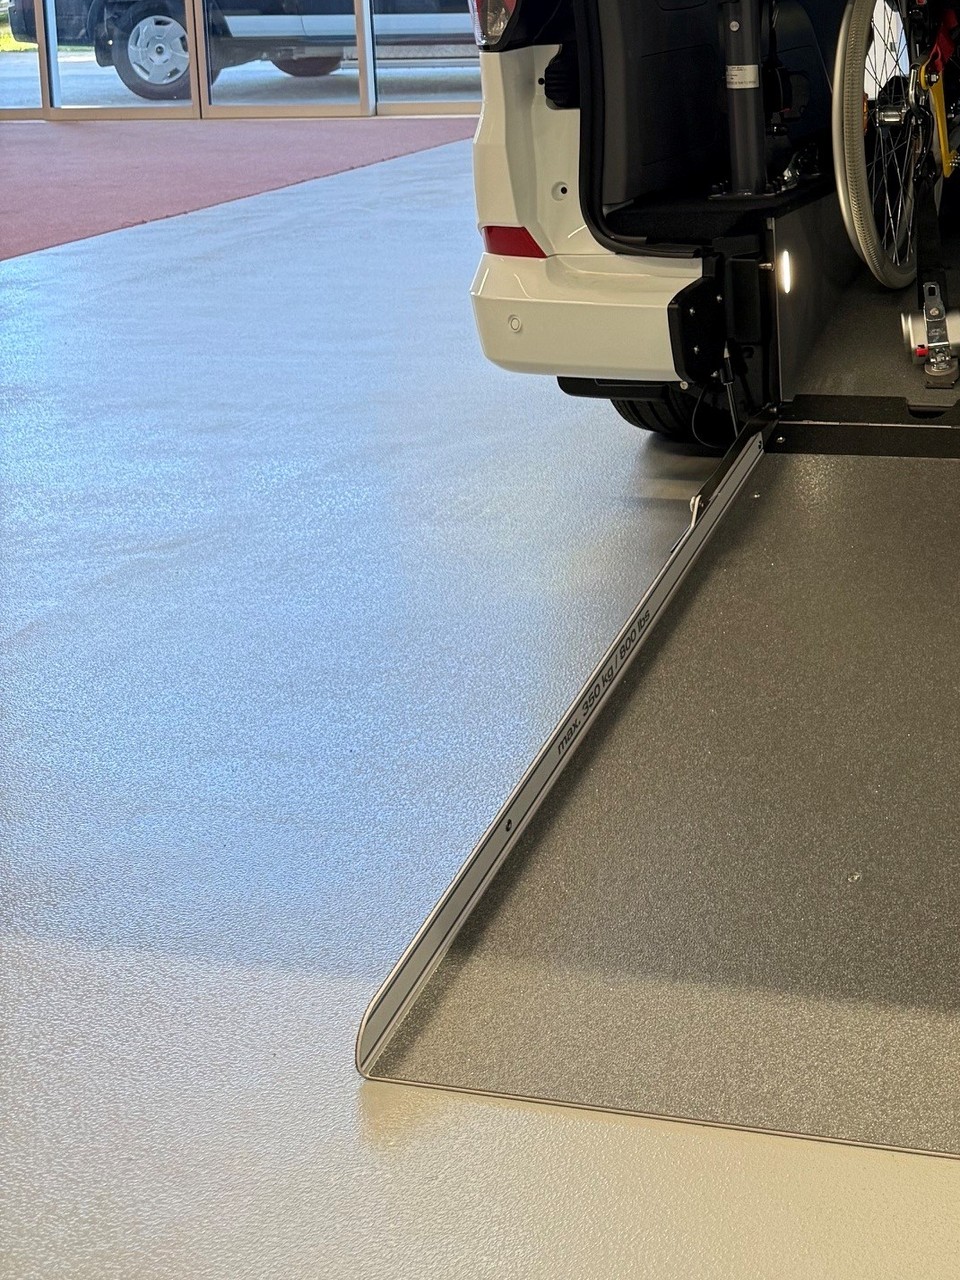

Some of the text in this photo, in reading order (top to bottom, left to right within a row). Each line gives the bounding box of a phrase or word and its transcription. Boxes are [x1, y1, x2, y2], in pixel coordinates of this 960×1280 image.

[557, 718, 581, 755] max.
[582, 683, 601, 716] 350
[601, 665, 614, 687] kg
[619, 628, 637, 660] 800
[637, 609, 650, 632] lbs
